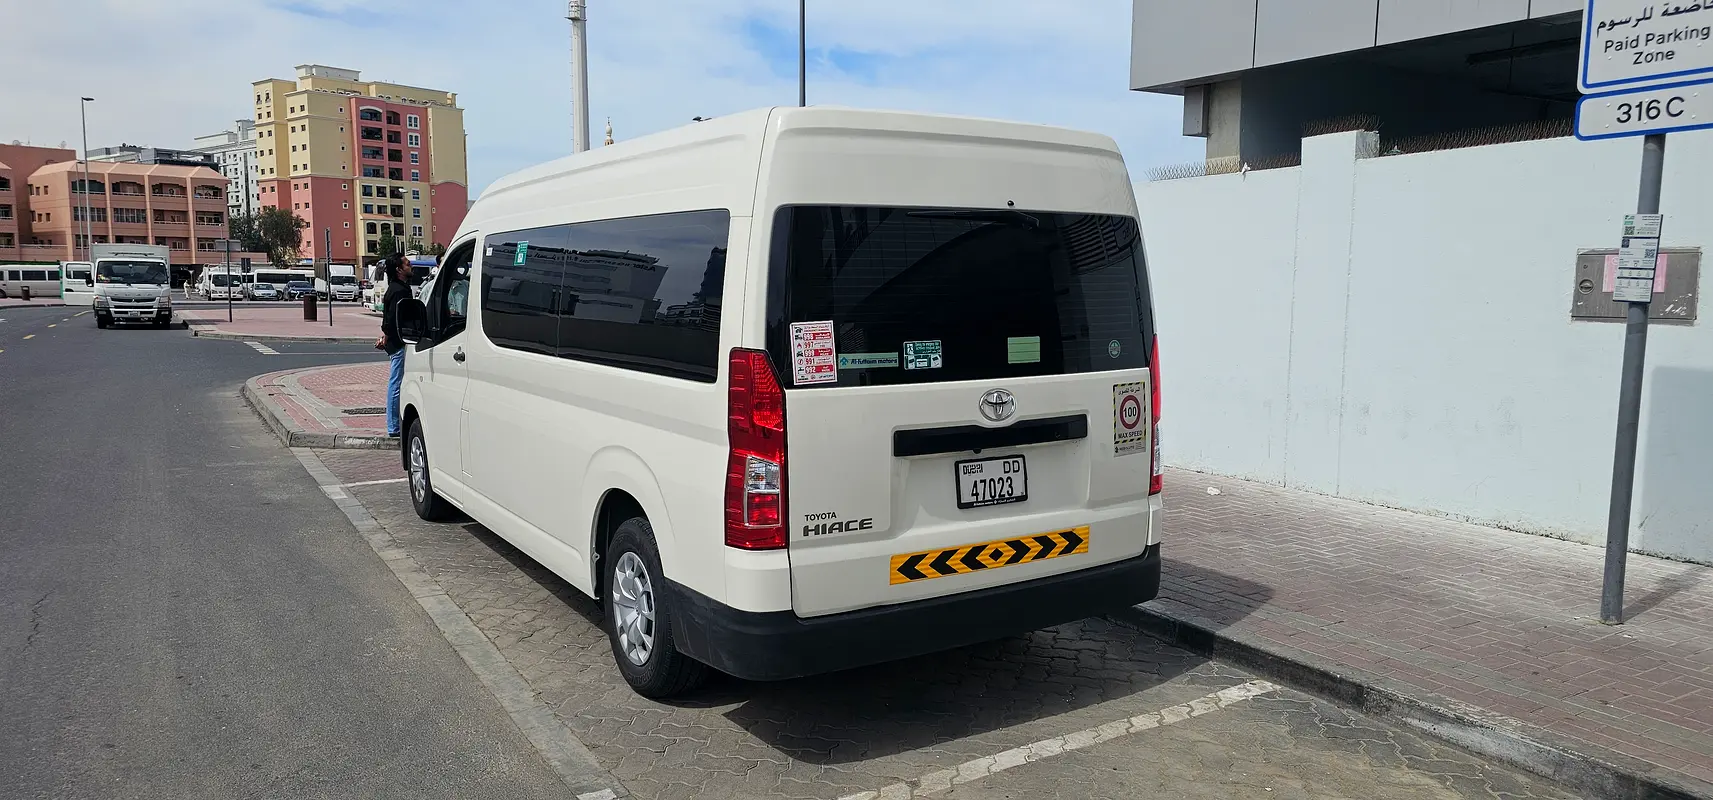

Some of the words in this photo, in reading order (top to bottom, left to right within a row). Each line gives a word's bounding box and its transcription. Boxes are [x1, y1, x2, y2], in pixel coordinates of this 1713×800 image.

[1596, 6, 1654, 38] للرسوم
[1604, 35, 1640, 53] Paid
[1644, 26, 1711, 47] Parking
[1633, 49, 1675, 65] Zone
[1123, 406, 1137, 418] 100
[1129, 430, 1143, 438] SPEED
[971, 476, 1014, 501] 47023
[804, 512, 837, 521] TOYOTA
[803, 518, 873, 537] HIACE
